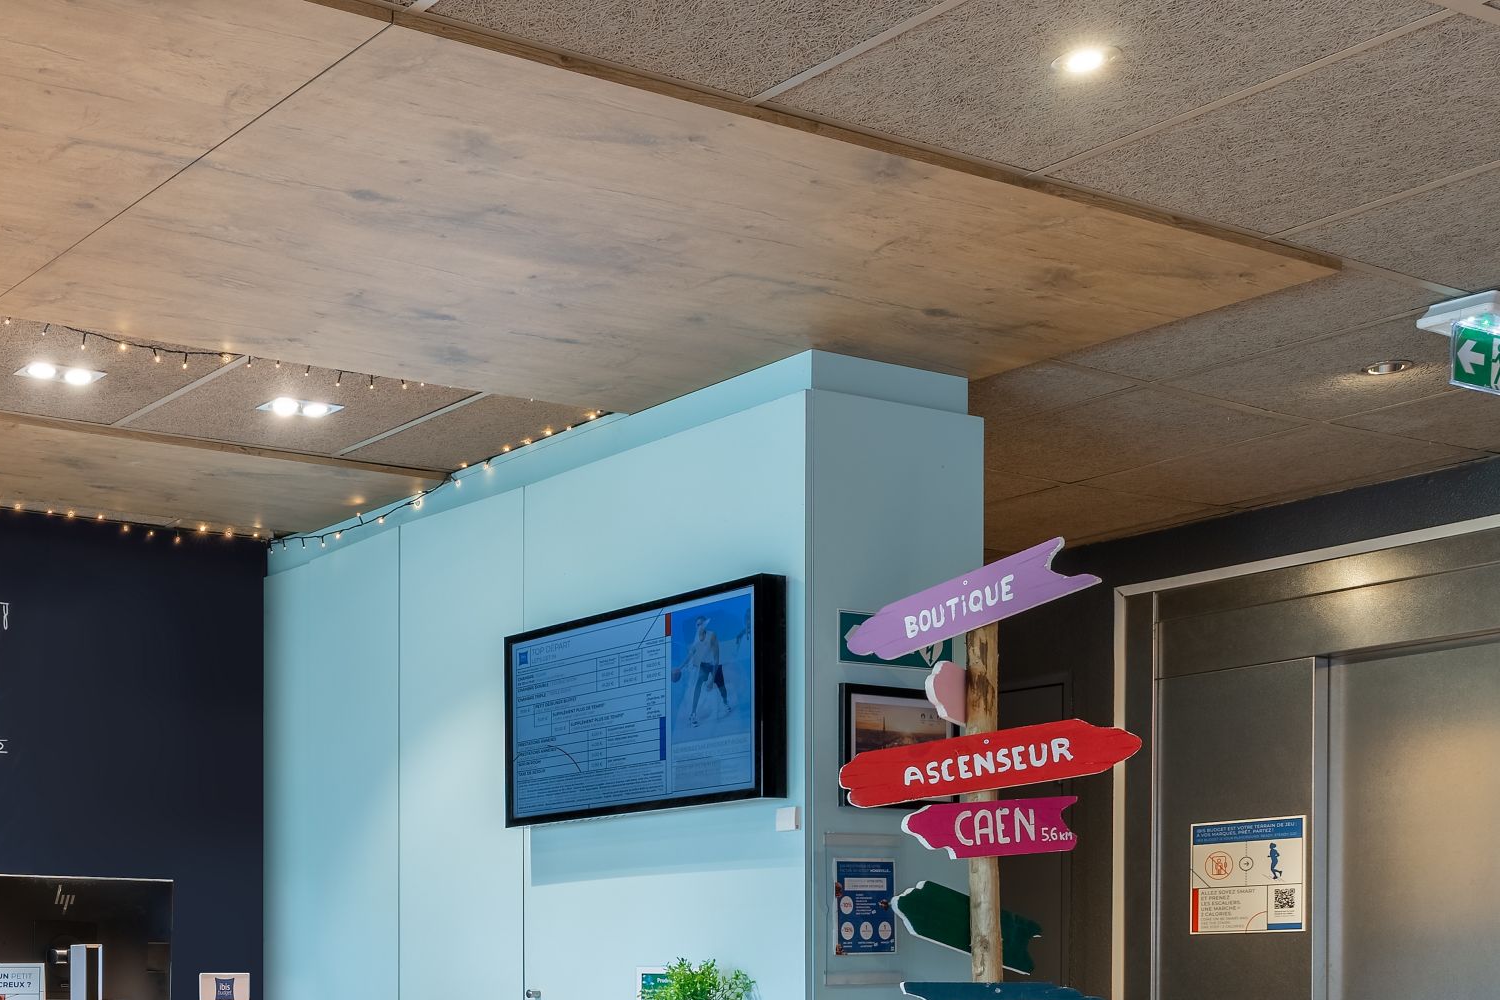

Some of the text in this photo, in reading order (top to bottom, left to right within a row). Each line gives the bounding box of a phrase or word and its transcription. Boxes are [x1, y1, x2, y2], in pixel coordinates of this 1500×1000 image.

[903, 737, 1074, 786] ASCENSEUR
[953, 807, 1036, 846] CAEN
[220, 982, 231, 991] ibis
